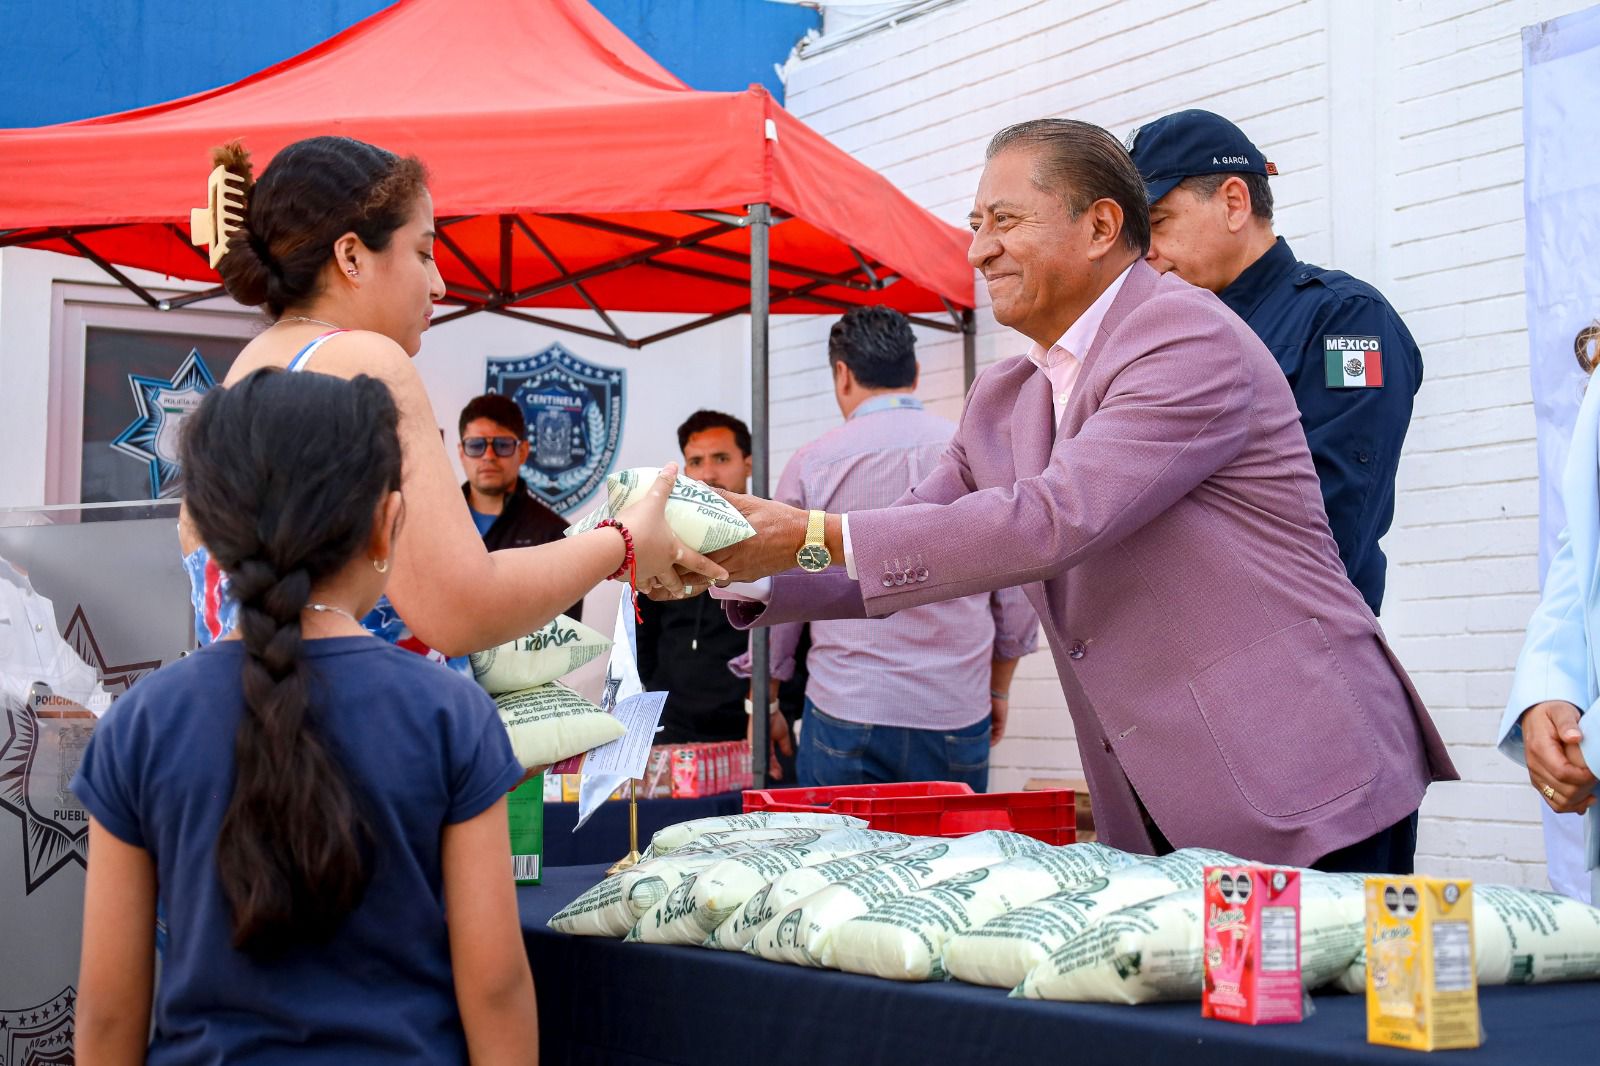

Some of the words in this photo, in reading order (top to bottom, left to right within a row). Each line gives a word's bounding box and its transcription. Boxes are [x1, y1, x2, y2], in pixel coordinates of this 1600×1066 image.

[1212, 156, 1221, 165] A.
[1222, 155, 1249, 165] GARCÍA
[1326, 337, 1379, 350] MÉXICO
[526, 393, 583, 407] CENTINELA
[696, 505, 749, 528] FORTIFICADA
[53, 809, 89, 821] PUEBL
